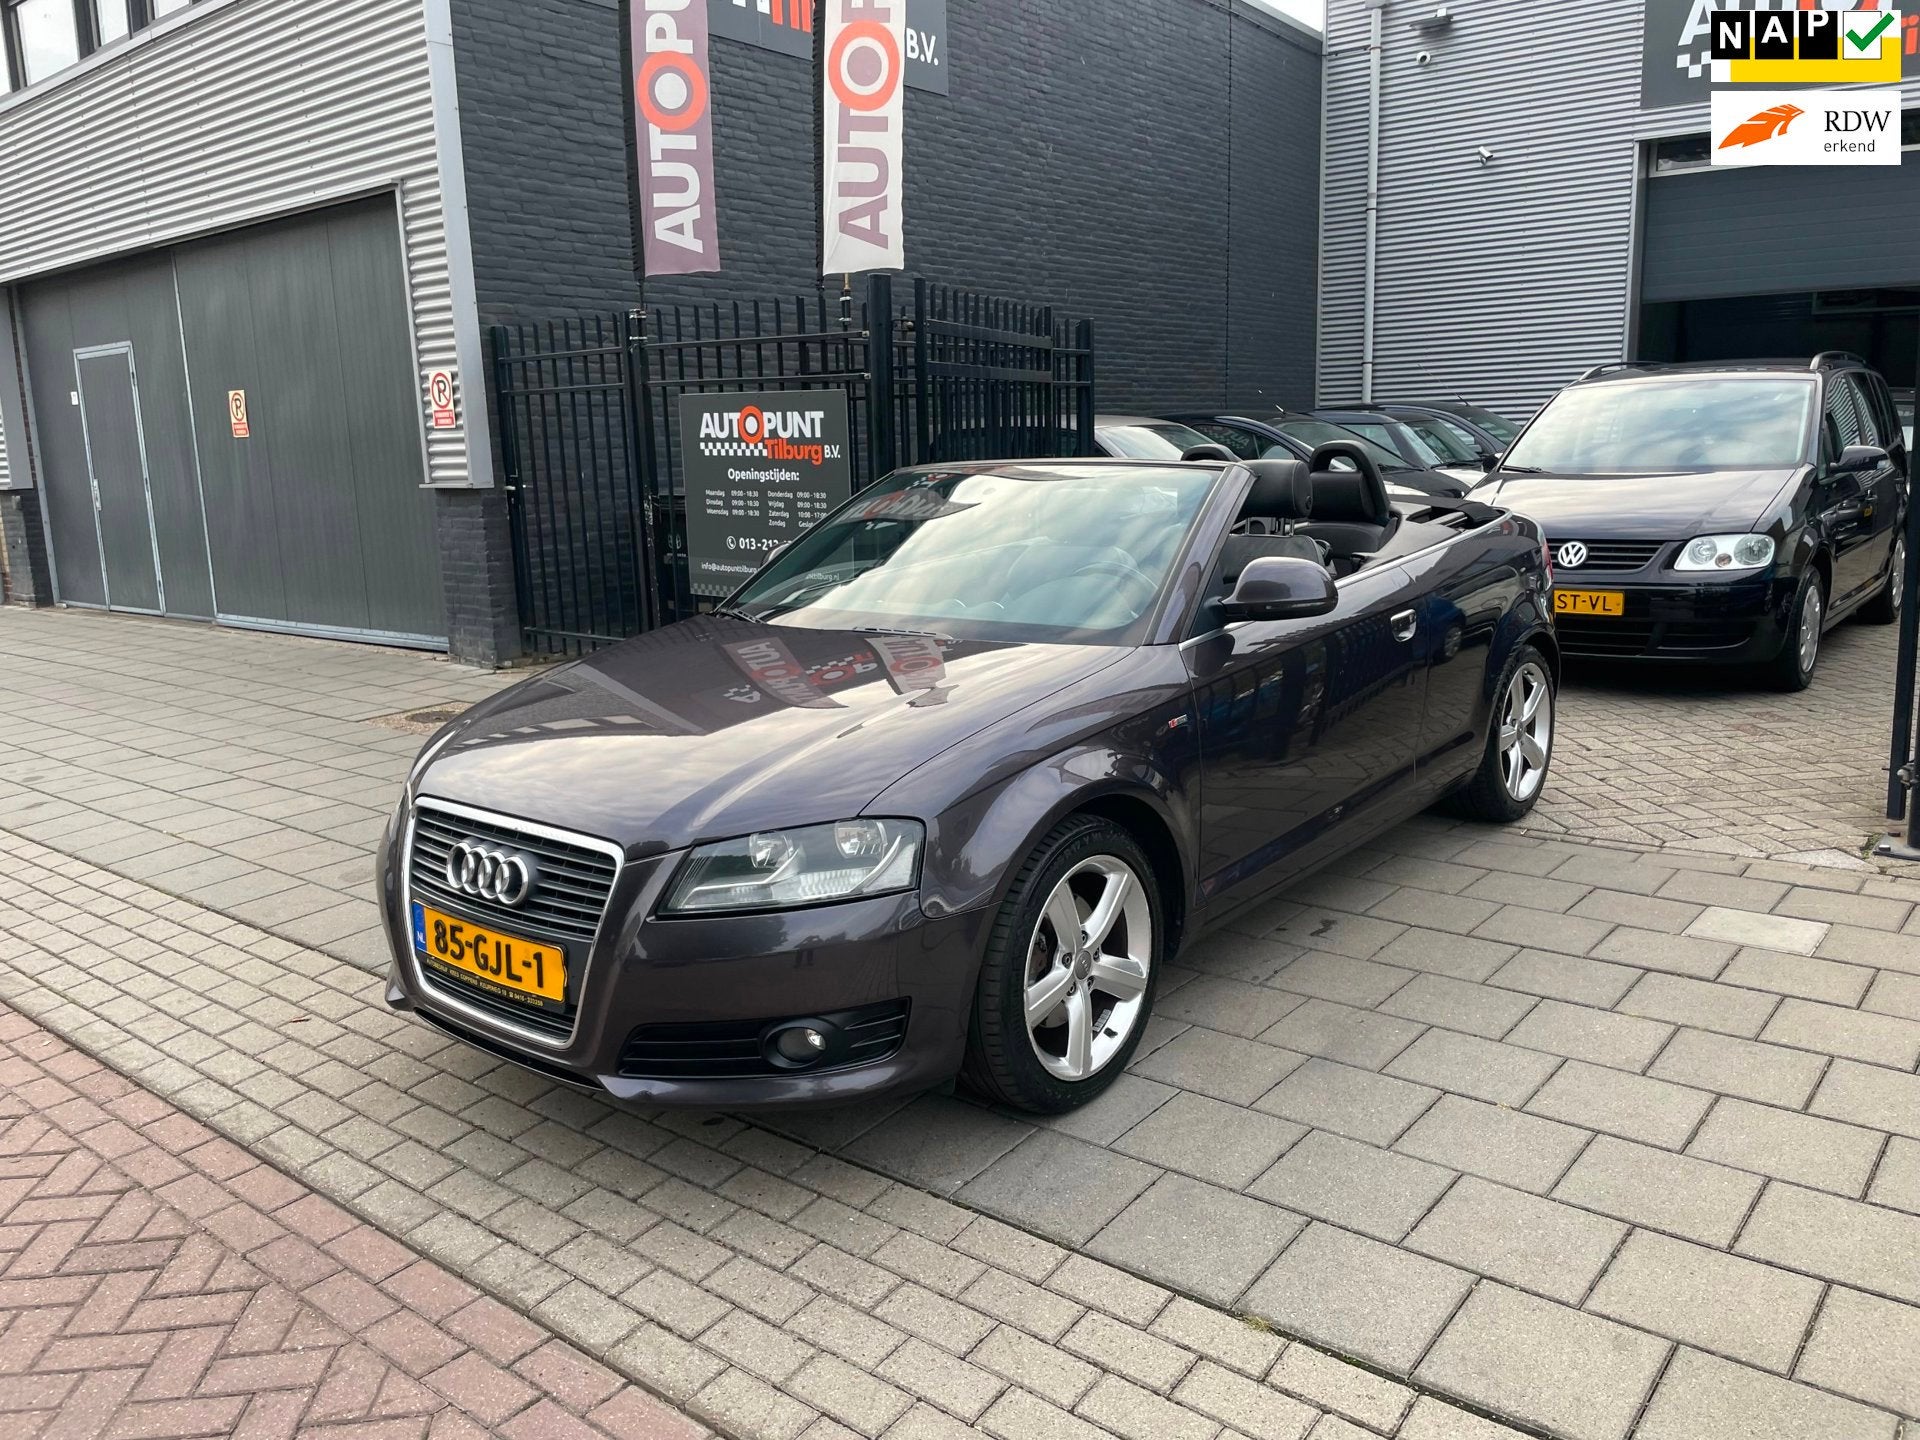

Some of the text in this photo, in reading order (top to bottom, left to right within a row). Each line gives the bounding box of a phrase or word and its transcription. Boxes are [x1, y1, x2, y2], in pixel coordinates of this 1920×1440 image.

[906, 28, 939, 66] B.V.
[637, 0, 707, 254] AUTOP
[700, 405, 824, 444] AUTOPUNT
[764, 438, 841, 466] Tilburg B.V.
[727, 468, 800, 483] Openingstijden:
[705, 489, 726, 498] Maandag
[767, 490, 794, 499] Donderdag
[796, 491, 811, 499] 09:00
[705, 498, 724, 507] Dinsdag
[767, 500, 785, 509] Vrijdag
[706, 508, 729, 516] Woensdag
[768, 509, 790, 519] Zaterdag
[768, 519, 786, 528] Zondag
[701, 562, 761, 573] info@autopunttilburg.
[1556, 593, 1613, 612] ST-VL
[417, 931, 426, 944] NL
[434, 919, 544, 989] 85-GJL-1
